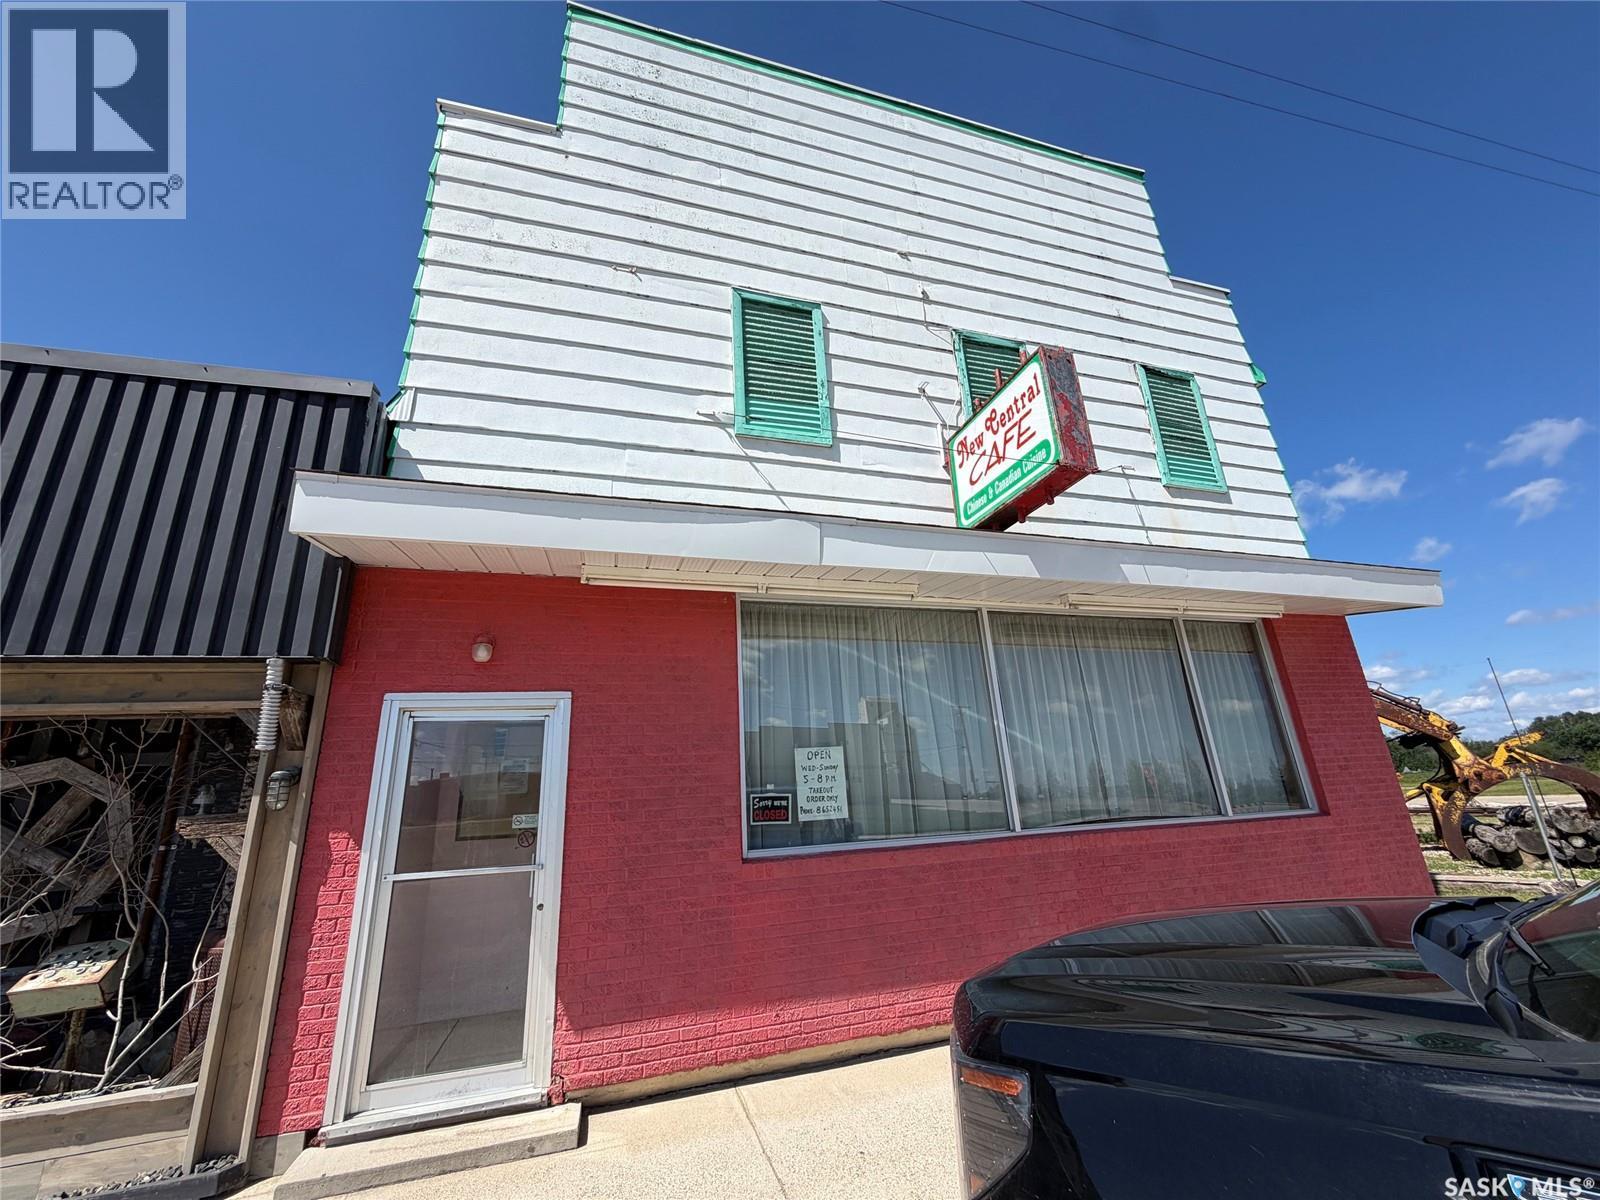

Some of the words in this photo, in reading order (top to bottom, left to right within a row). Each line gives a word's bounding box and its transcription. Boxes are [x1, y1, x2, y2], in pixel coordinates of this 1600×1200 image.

[956, 431, 985, 469] New
[985, 372, 1041, 435] Central
[969, 408, 1037, 486] CAFE
[966, 494, 988, 515] Chinese
[988, 486, 994, 499] &
[994, 467, 1022, 495] Canadian
[1022, 447, 1047, 473] Cuisine
[807, 750, 831, 760] OPEN
[808, 786, 834, 794] TAKEOUT
[753, 798, 772, 809] Sorry
[806, 795, 826, 803] ORDER
[754, 809, 788, 821] CLOSED
